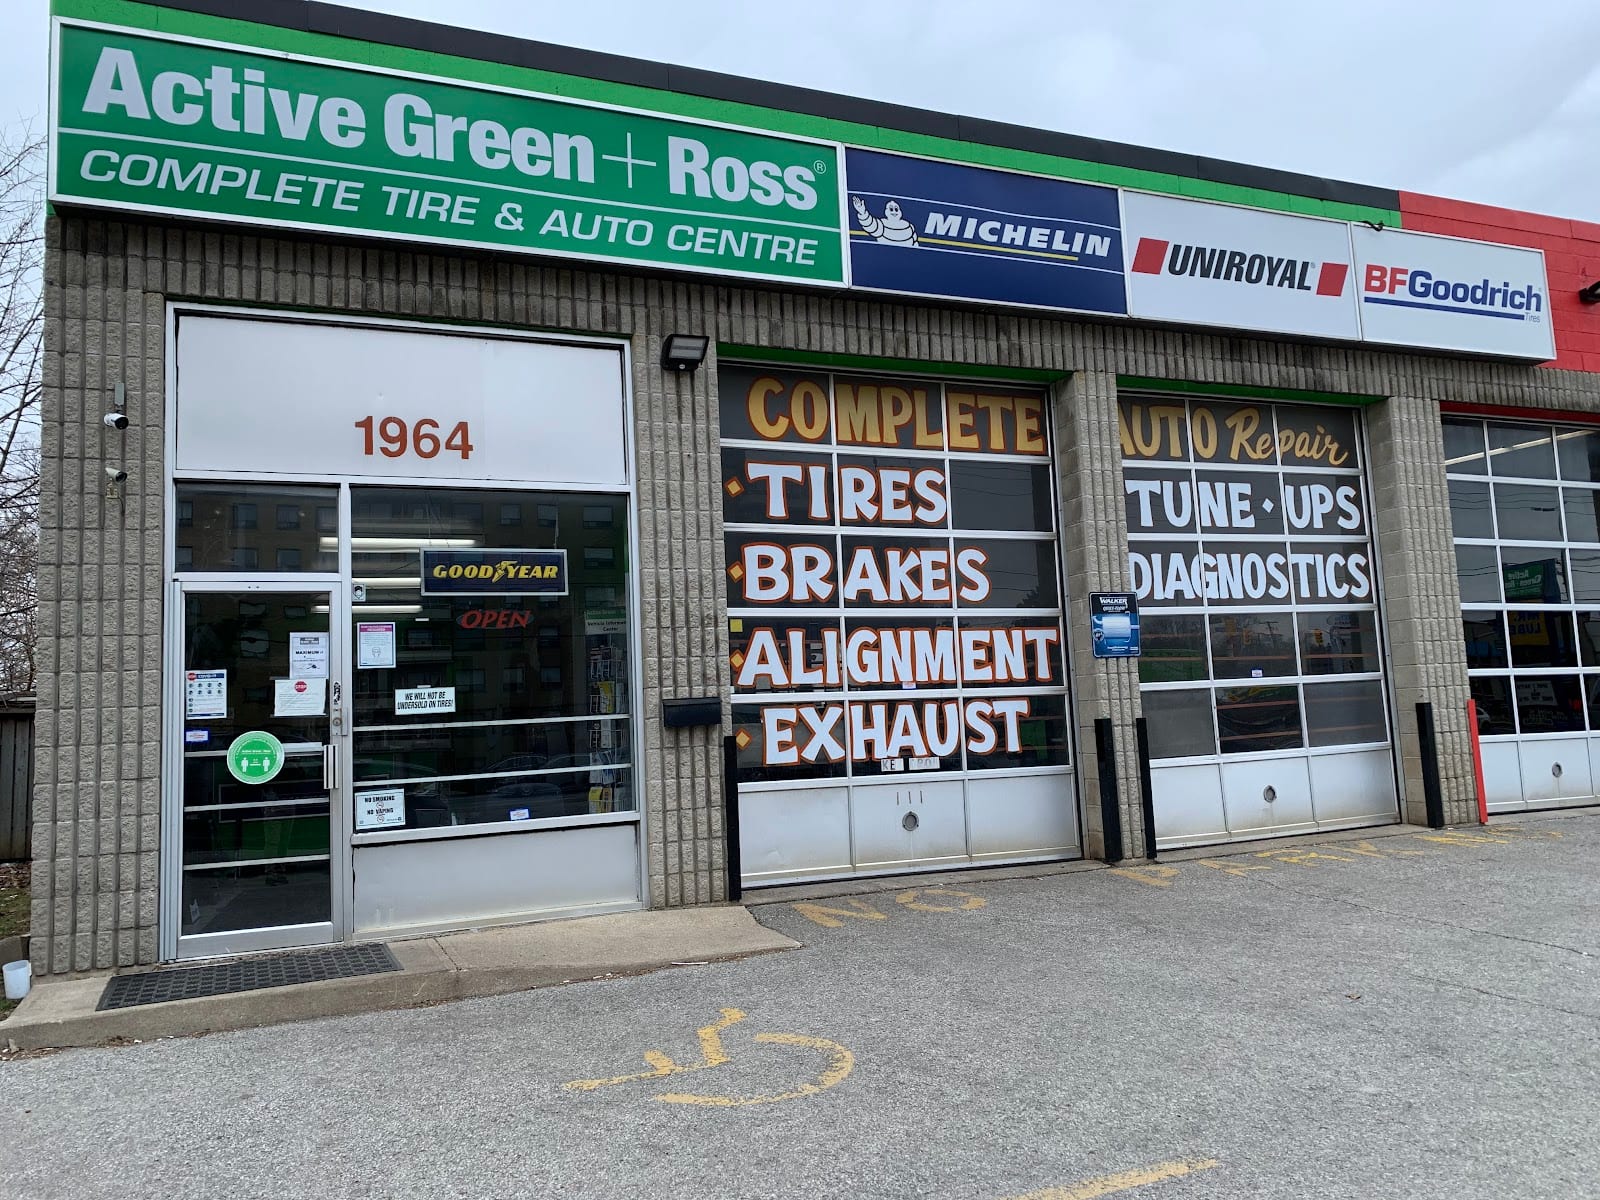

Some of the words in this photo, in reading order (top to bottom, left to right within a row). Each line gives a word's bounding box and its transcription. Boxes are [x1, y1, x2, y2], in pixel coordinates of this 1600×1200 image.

[82, 46, 366, 149] Active
[383, 92, 594, 184] Green
[79, 149, 363, 213] COMPLETE
[382, 186, 478, 226] TIRE
[494, 202, 525, 232] &
[539, 209, 655, 248] AUTO
[666, 223, 820, 268] CENTRE
[923, 211, 1112, 258] MICHELIN
[1168, 243, 1312, 292] UNIROYAL
[1363, 263, 1542, 313] BFGoodrich
[1524, 312, 1541, 323] Tires
[354, 415, 474, 460] 1964
[747, 377, 1046, 454] COMPLETE
[1118, 404, 1218, 459] AUTO
[1225, 406, 1348, 466] Repair
[745, 461, 948, 523] TIRES
[1124, 479, 1256, 528] TUNE
[1283, 484, 1361, 530] UPS
[742, 543, 992, 603] BRAKES
[1127, 552, 1371, 601] DIAGNOSTICS
[460, 609, 531, 630] OPEN
[1099, 597, 1128, 608] WALKER
[734, 626, 1060, 687] ALIGNMENT
[397, 701, 428, 710] UNDERSOLD
[428, 700, 436, 708] ON
[405, 693, 413, 701] WE
[414, 692, 426, 700] WILL
[438, 691, 446, 699] BE
[760, 696, 1030, 767] EXHAUST
[792, 888, 988, 929] NO
[1109, 825, 1564, 888] PARKNG
